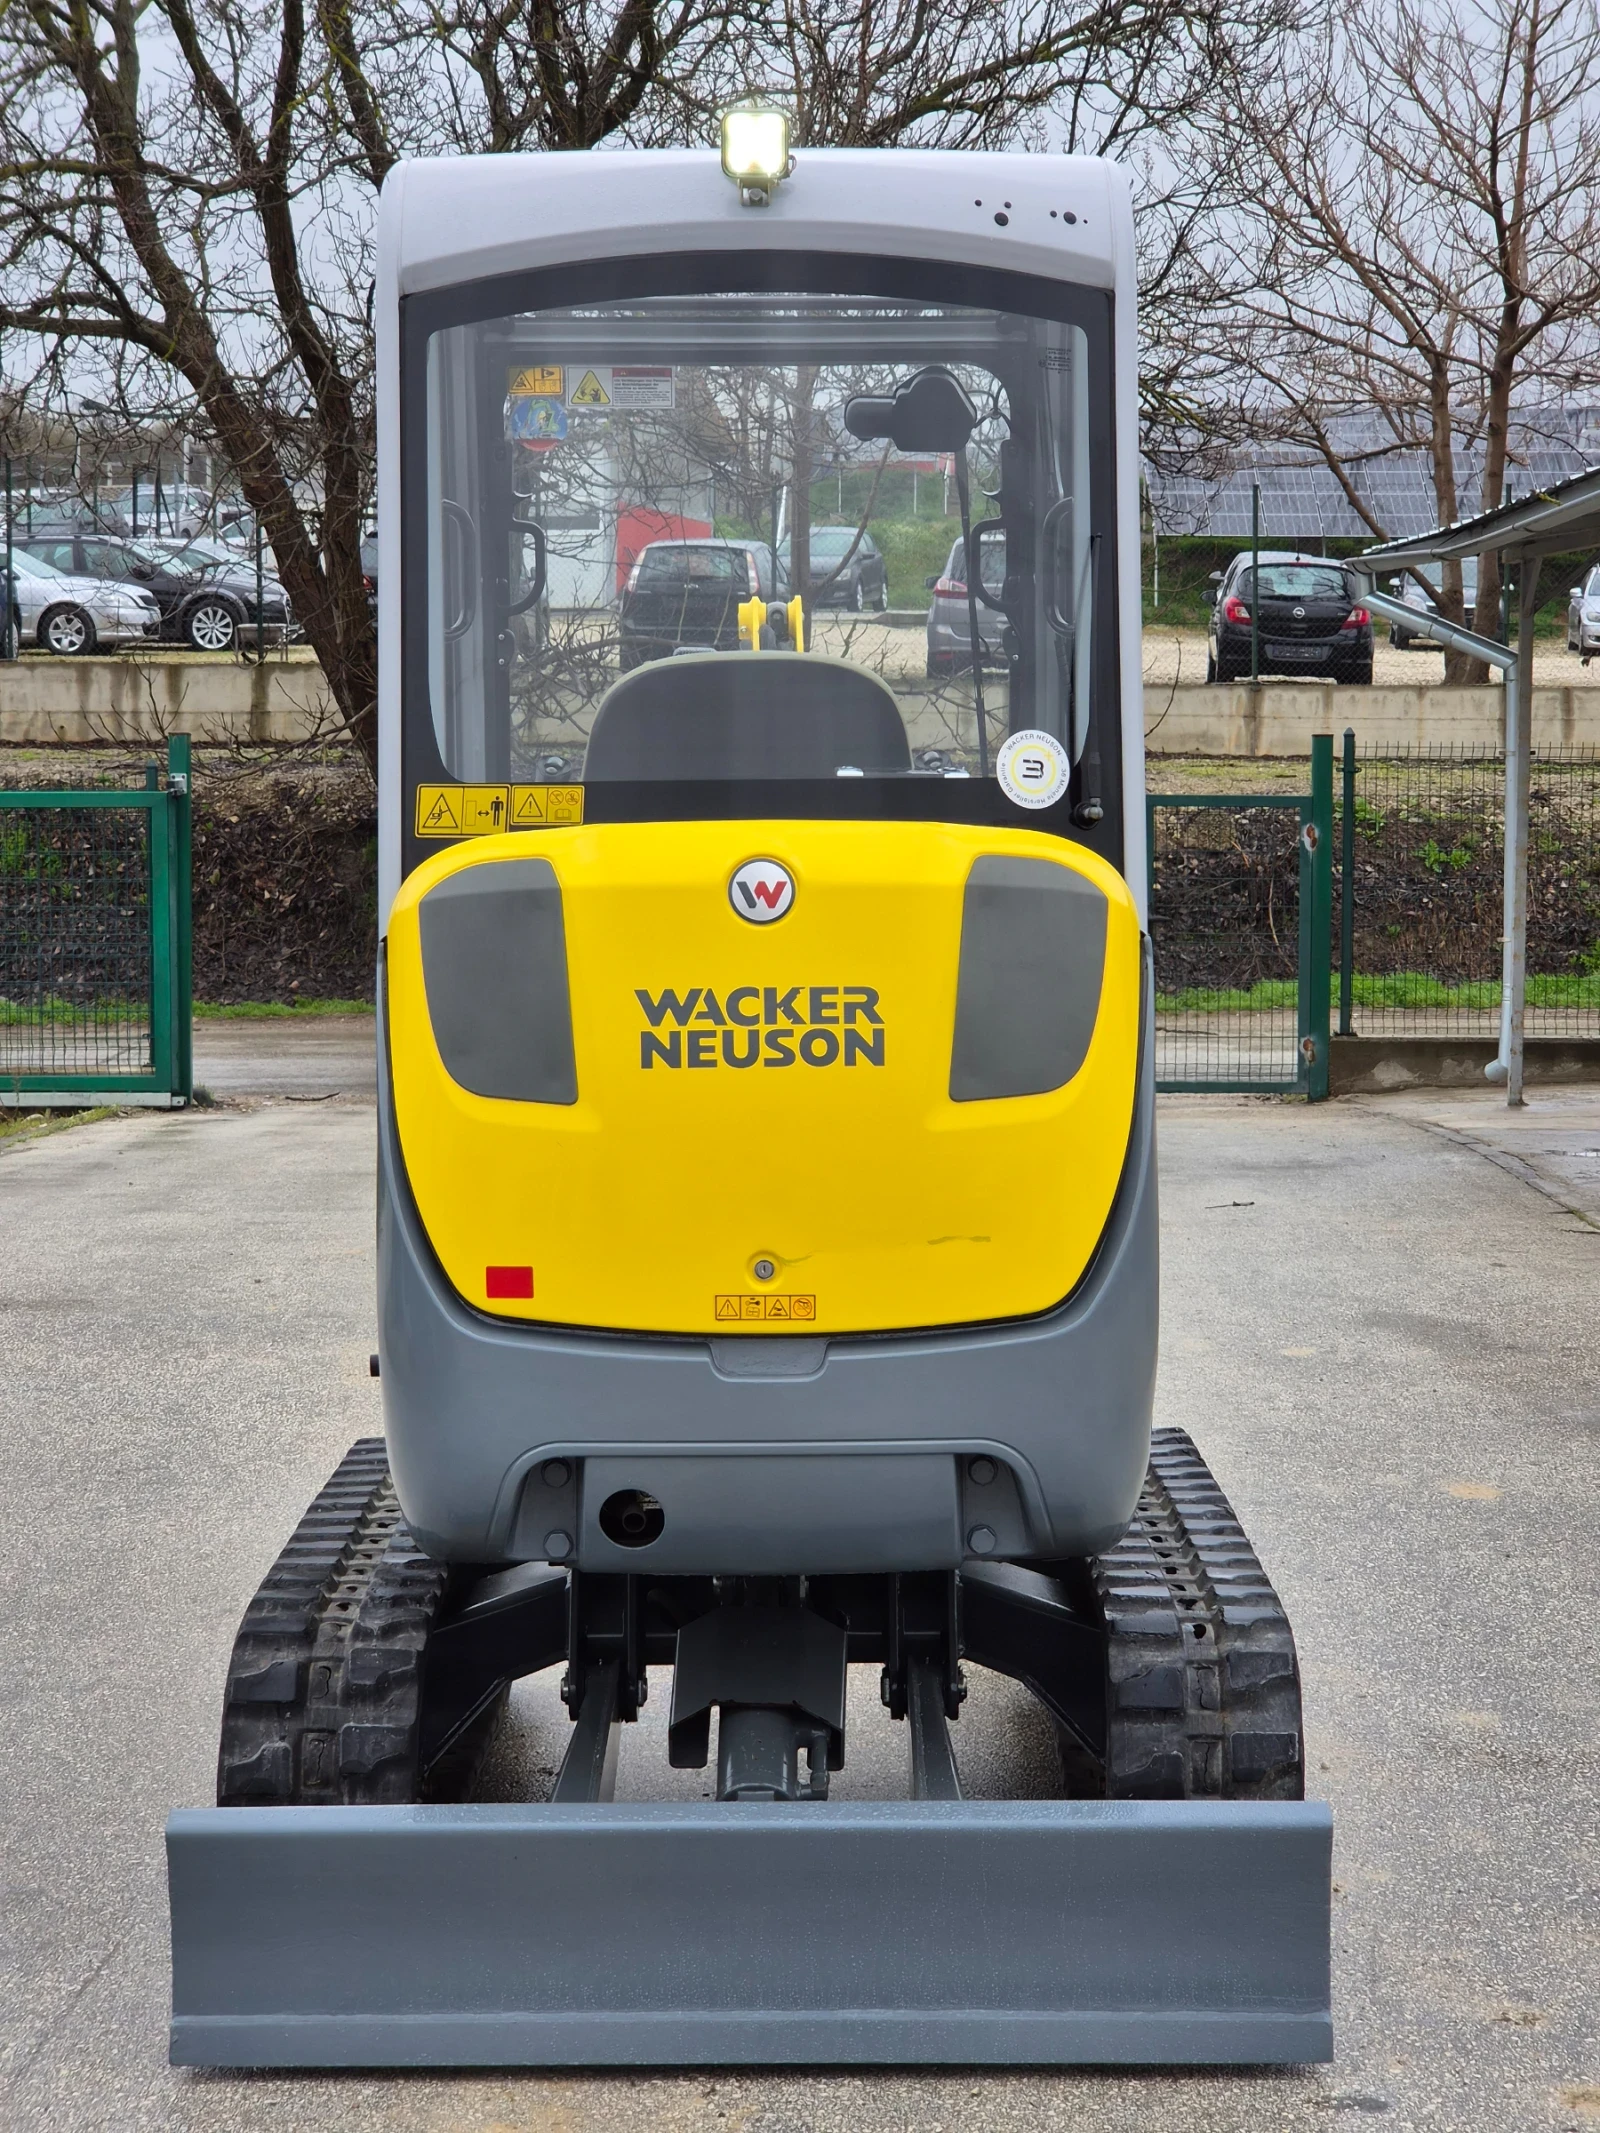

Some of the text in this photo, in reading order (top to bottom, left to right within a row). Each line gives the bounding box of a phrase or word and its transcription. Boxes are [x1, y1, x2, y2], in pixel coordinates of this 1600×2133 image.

[1006, 733, 1063, 756] WACKER NEUSON
[1000, 762, 1014, 793] Garantie
[1013, 792, 1046, 804] Hersteller
[633, 986, 885, 1027] WACKER
[640, 1028, 885, 1069] NEUSON
